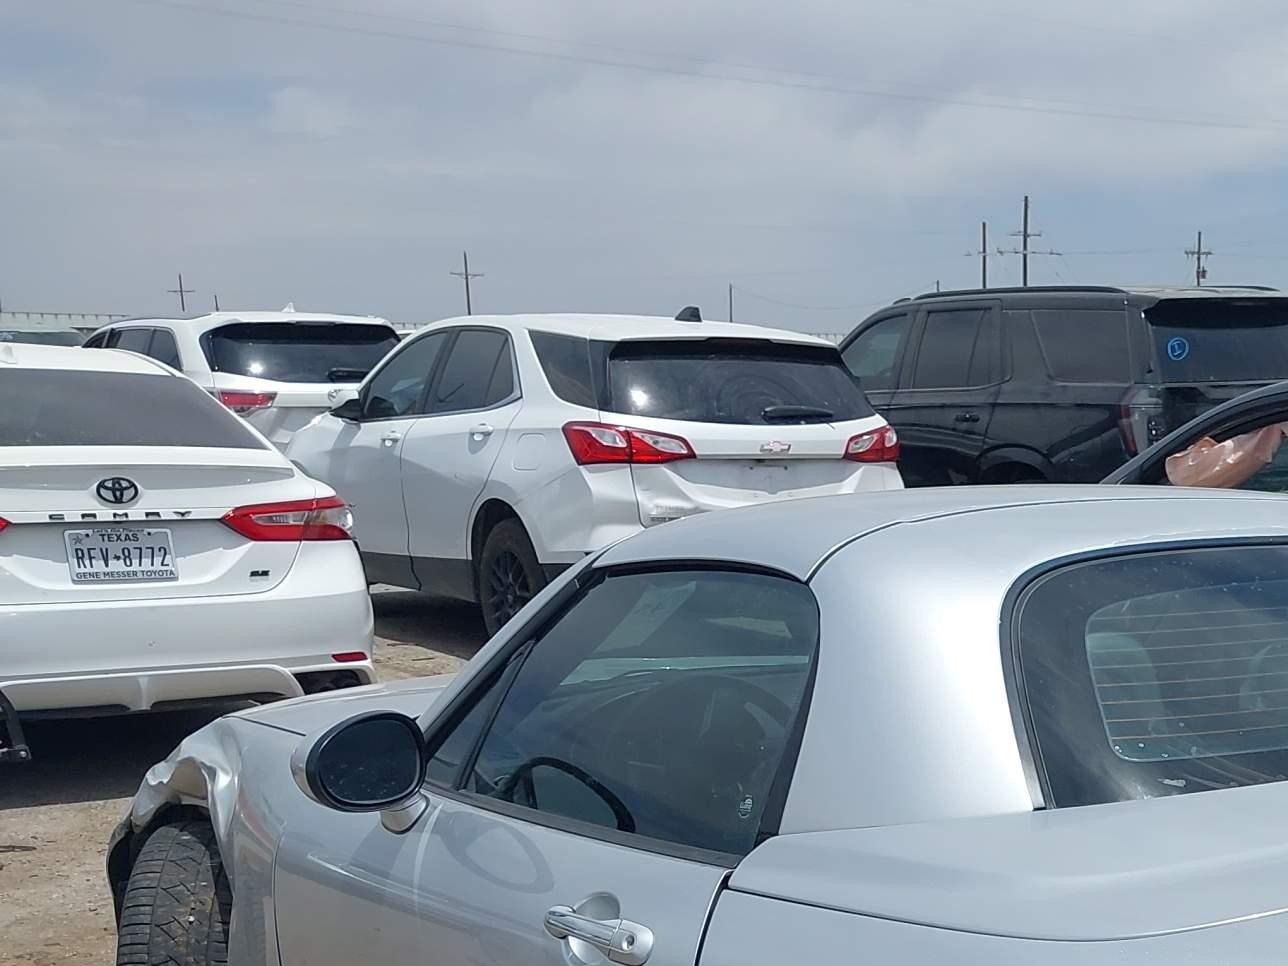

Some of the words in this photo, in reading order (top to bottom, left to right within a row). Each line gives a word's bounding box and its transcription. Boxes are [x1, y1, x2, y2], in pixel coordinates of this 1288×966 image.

[48, 510, 192, 521] CAMRY
[99, 533, 139, 543] TEXAS
[76, 571, 101, 580] GENE
[103, 570, 138, 579] MESSER
[141, 569, 175, 578] TOYOTA
